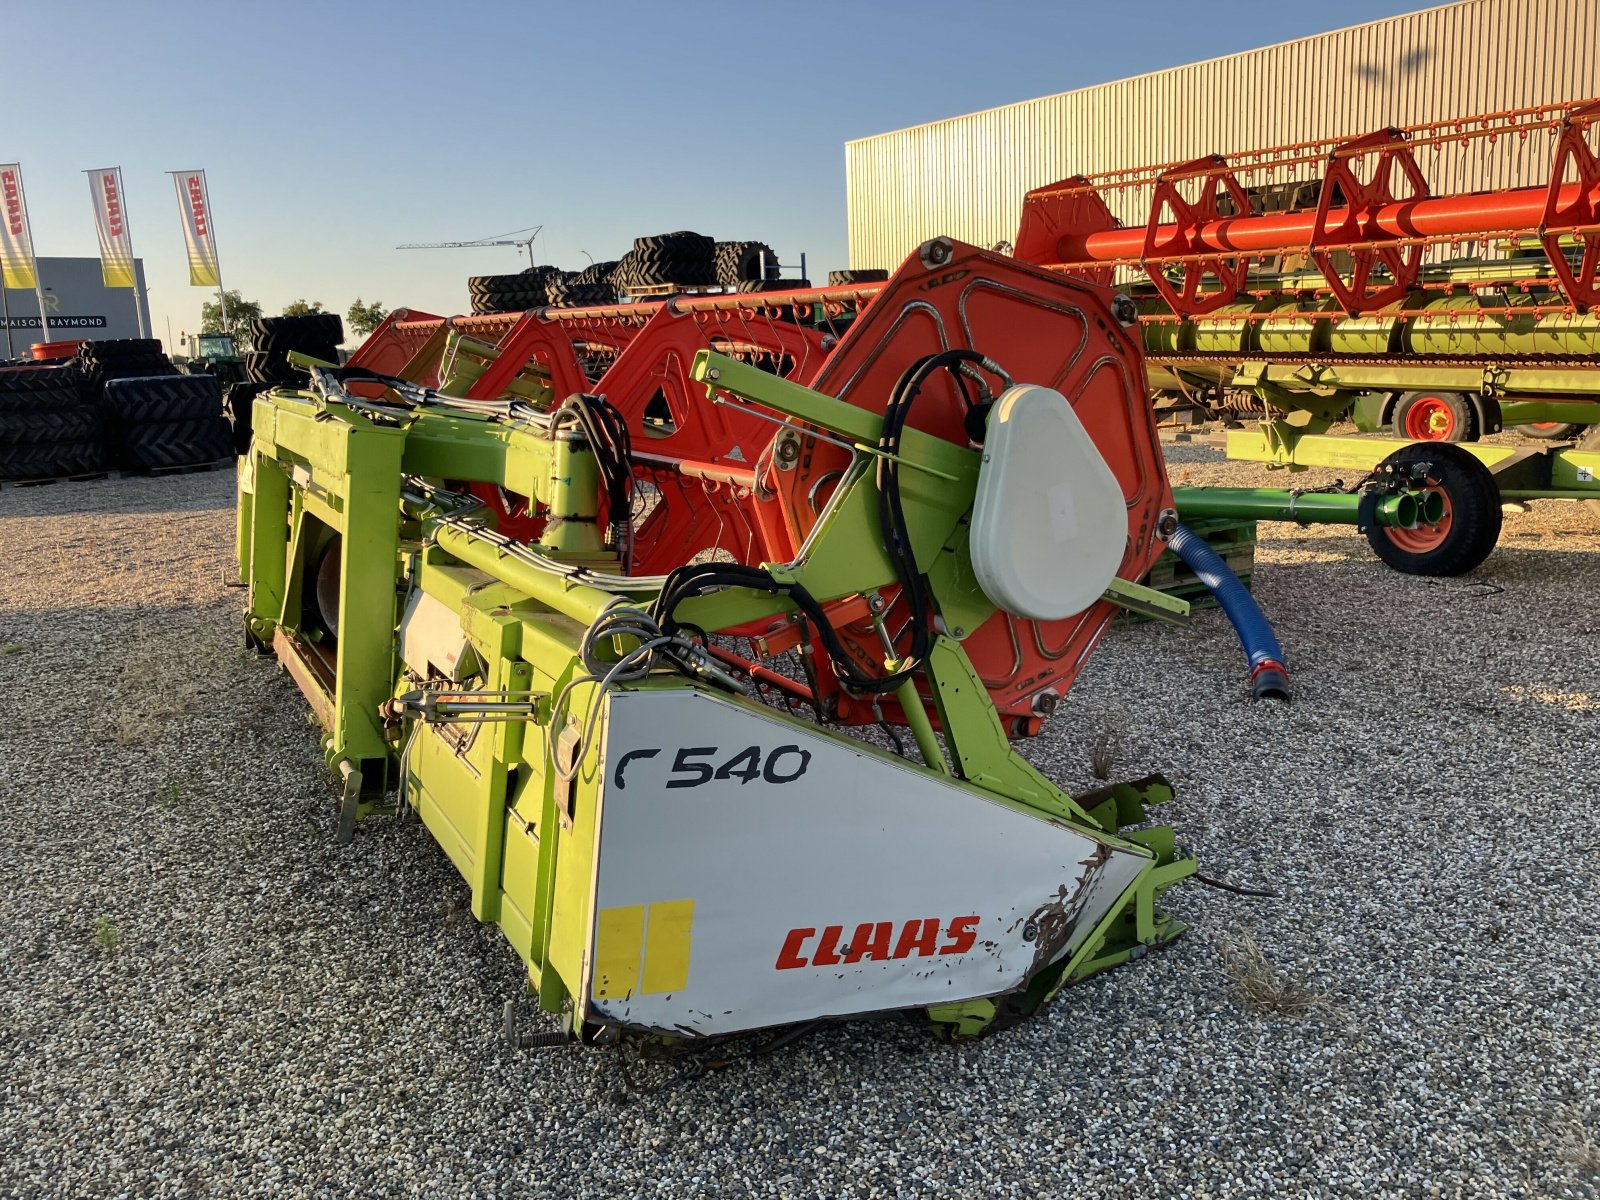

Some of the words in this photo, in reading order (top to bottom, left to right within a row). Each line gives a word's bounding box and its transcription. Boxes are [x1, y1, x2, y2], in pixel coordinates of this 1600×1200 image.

[1, 319, 43, 327] MAISON
[50, 318, 103, 326] RAYMOND
[666, 744, 812, 789] 540
[775, 915, 980, 970] CLAAS
